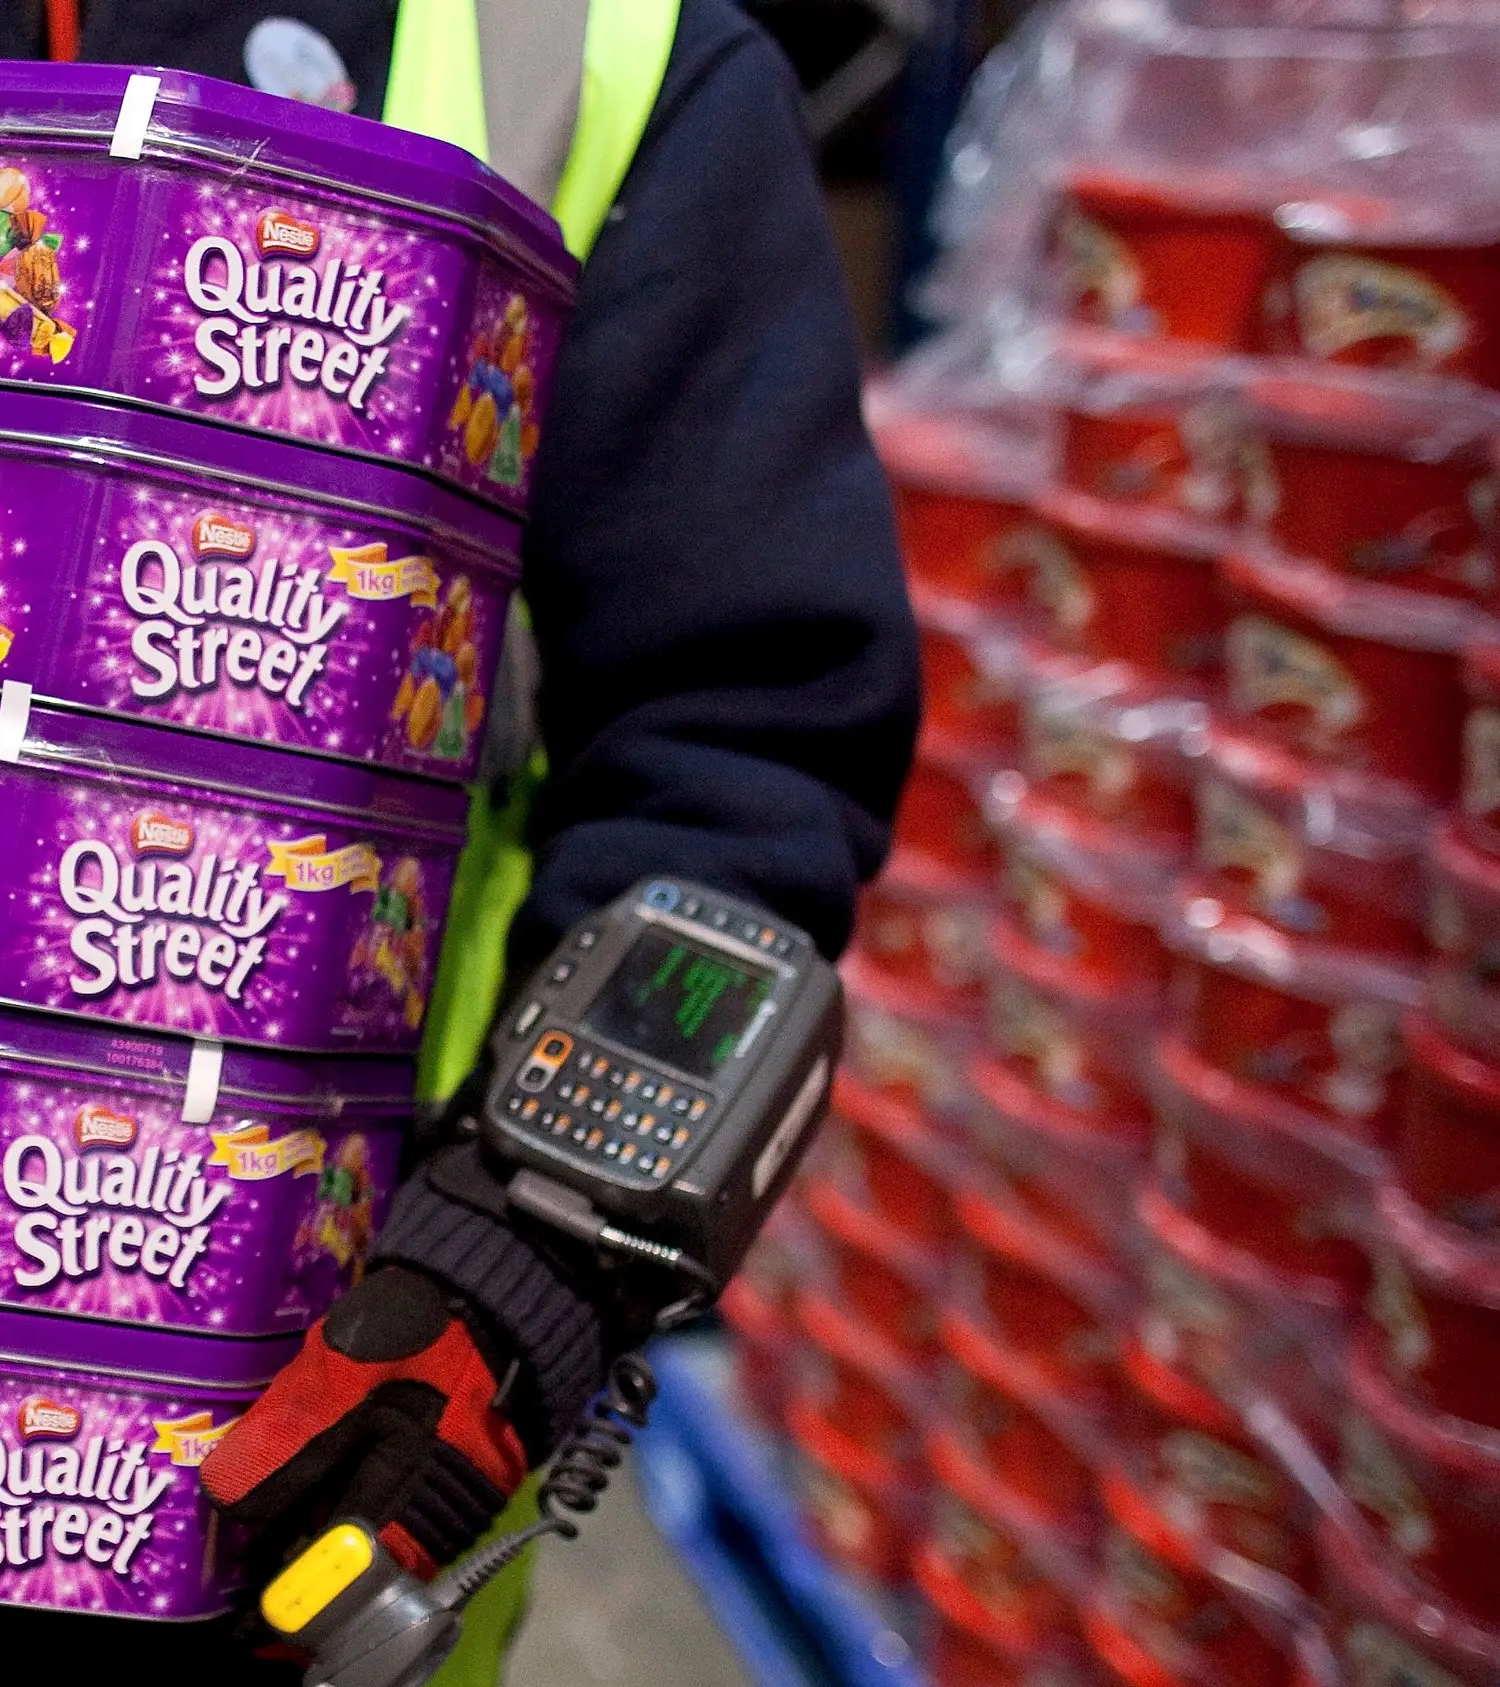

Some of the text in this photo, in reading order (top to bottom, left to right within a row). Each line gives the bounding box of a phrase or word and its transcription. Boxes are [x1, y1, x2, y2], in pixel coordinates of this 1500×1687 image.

[184, 235, 409, 346] Quality
[194, 316, 390, 409] Street
[121, 539, 348, 644] Quality
[356, 568, 394, 594] 1kg
[130, 619, 327, 706] Street
[59, 839, 288, 938] Quality
[295, 860, 334, 887] 1kg
[70, 918, 267, 999] Street
[3, 1135, 232, 1228] Quality
[239, 1150, 278, 1175] 1kg
[13, 1211, 210, 1288] Street
